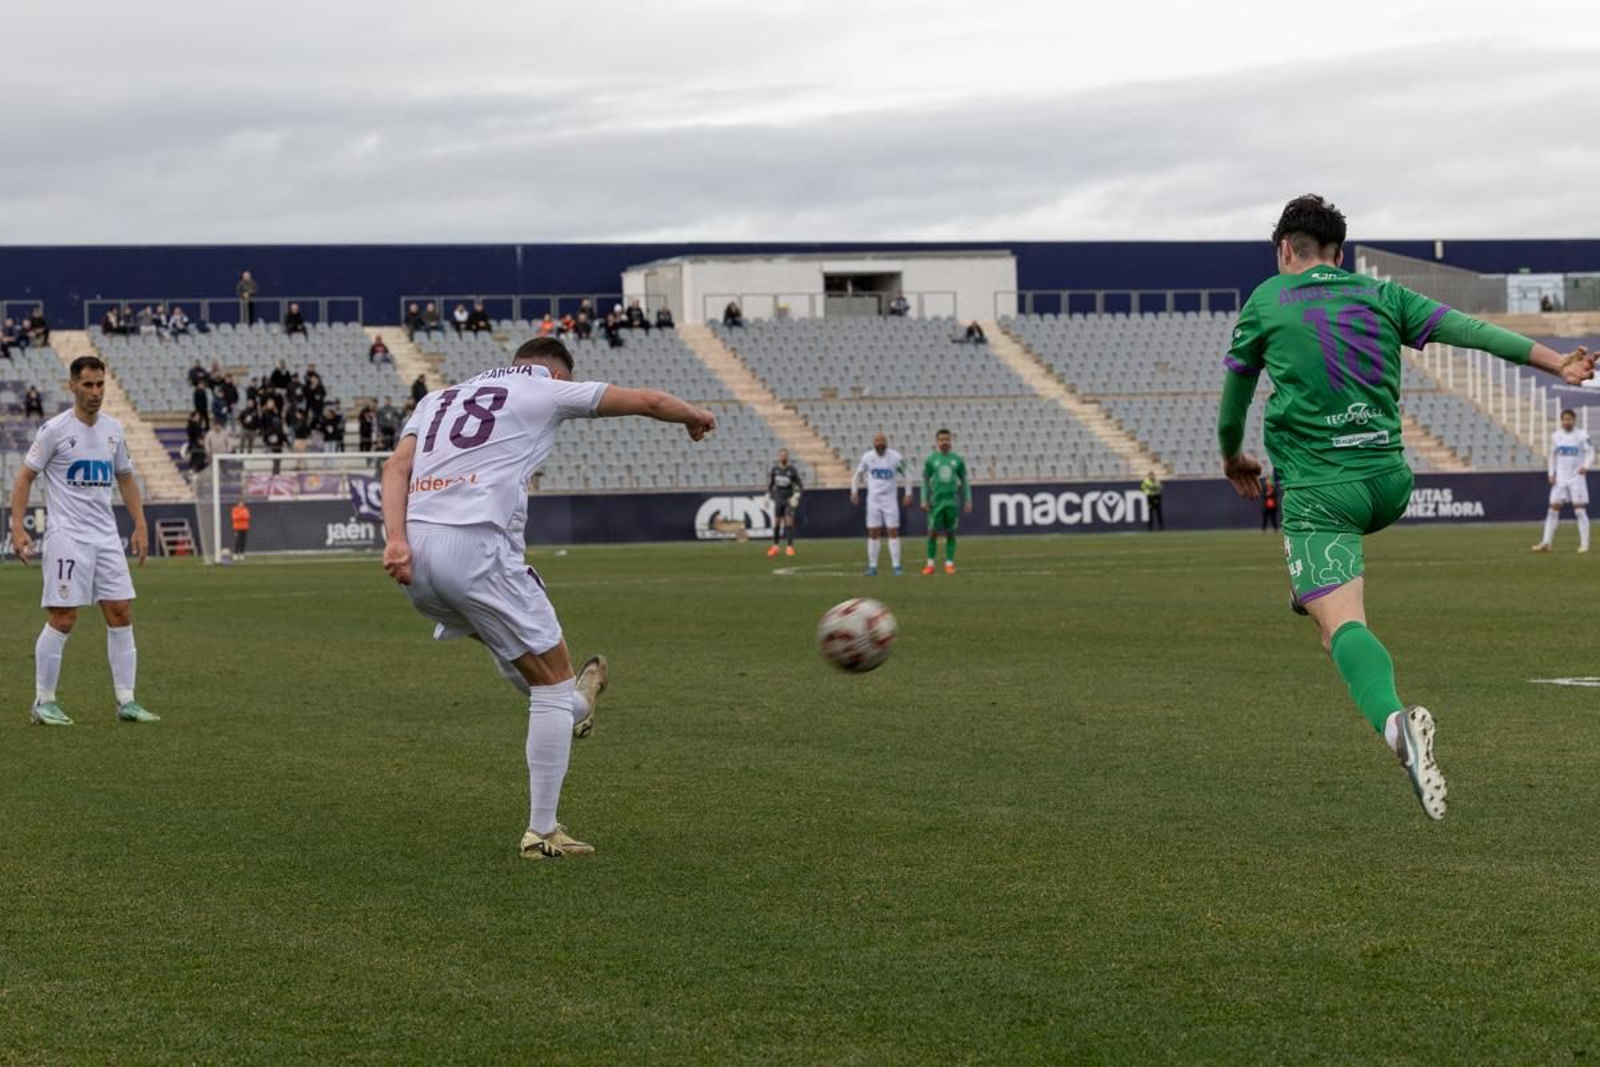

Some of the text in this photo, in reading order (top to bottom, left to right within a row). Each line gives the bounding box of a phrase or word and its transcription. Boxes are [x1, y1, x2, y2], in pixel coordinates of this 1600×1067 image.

[1302, 304, 1384, 391] 18
[423, 386, 509, 453] 18
[989, 490, 1150, 527] macron
[1438, 501, 1486, 518] MORA
[57, 558, 75, 581] 17
